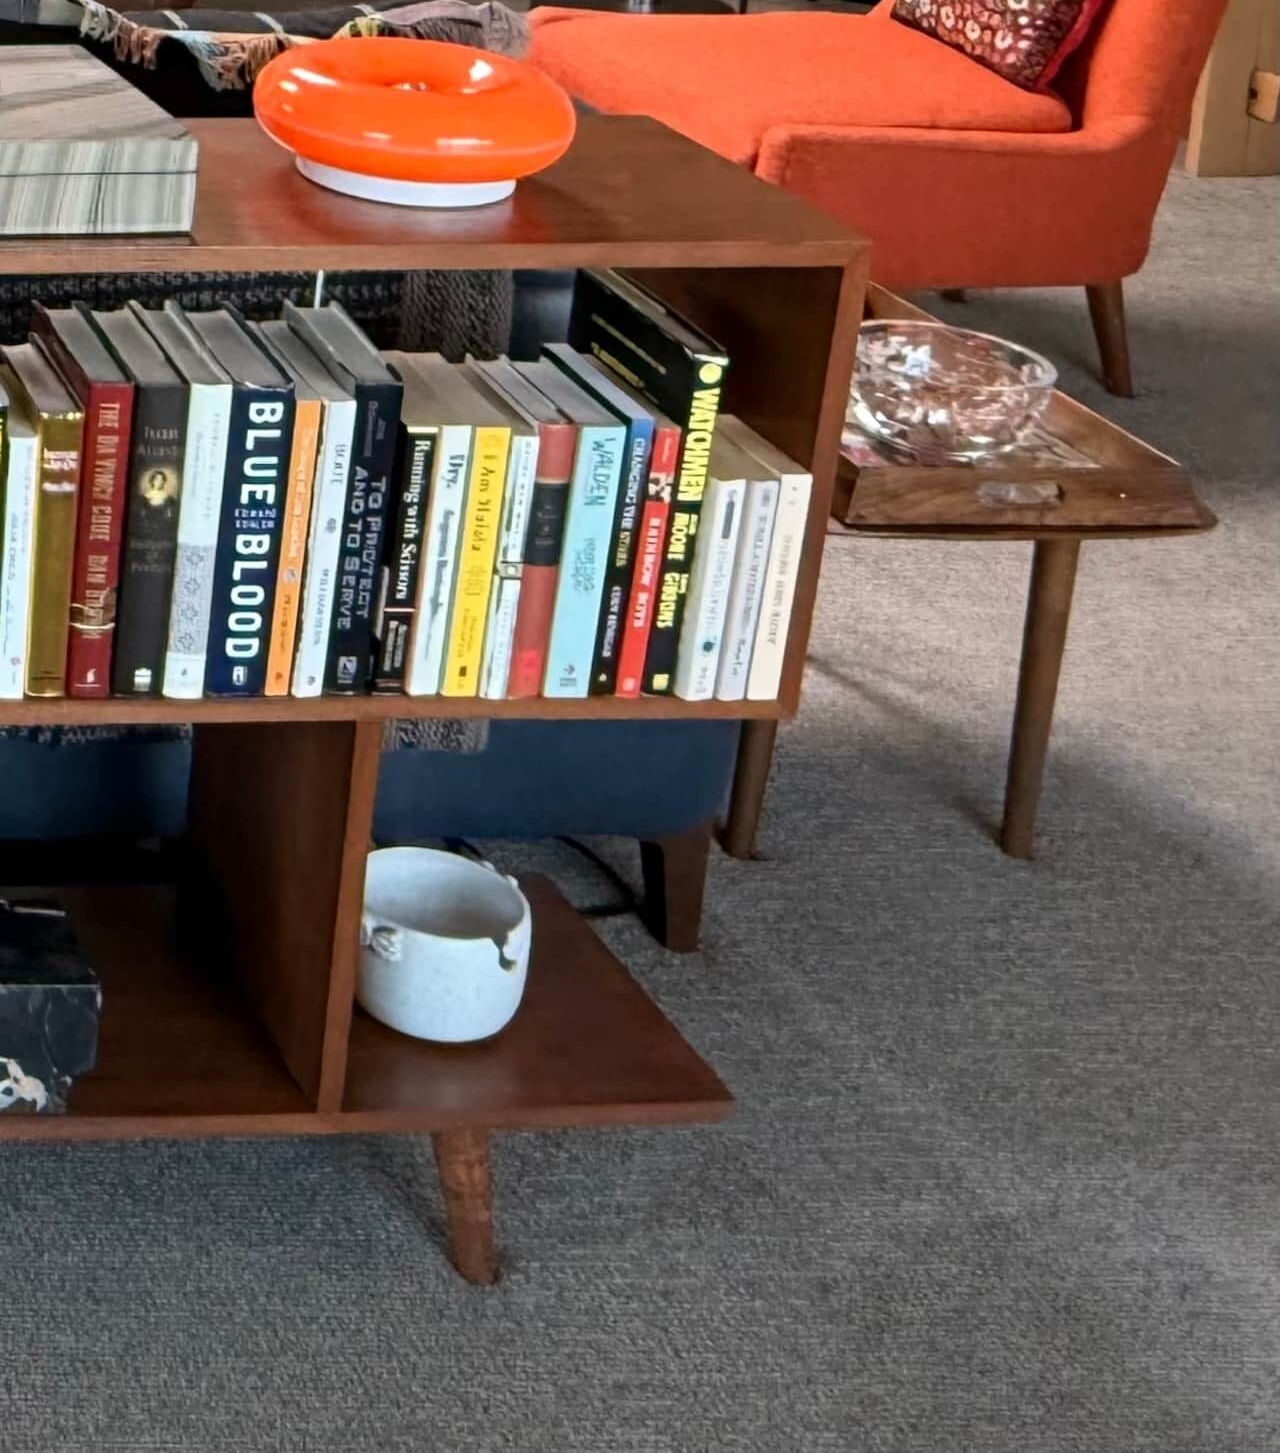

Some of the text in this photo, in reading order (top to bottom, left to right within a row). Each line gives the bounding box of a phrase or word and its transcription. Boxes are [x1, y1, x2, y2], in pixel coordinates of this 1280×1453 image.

[89, 401, 121, 541] THE DA VINCI CODE
[240, 401, 285, 505] BLUE
[403, 439, 432, 504] Running
[583, 437, 617, 507] WALDEN
[677, 387, 721, 502] WATCHMEN
[368, 475, 387, 508] TO
[402, 504, 421, 539] with
[85, 553, 108, 583] DAN
[336, 465, 370, 632] AND TO SERVE
[354, 515, 381, 619] PROTECT
[394, 543, 419, 600] Scissors
[640, 516, 662, 587] RAINBOW
[224, 533, 271, 658] BLOOD
